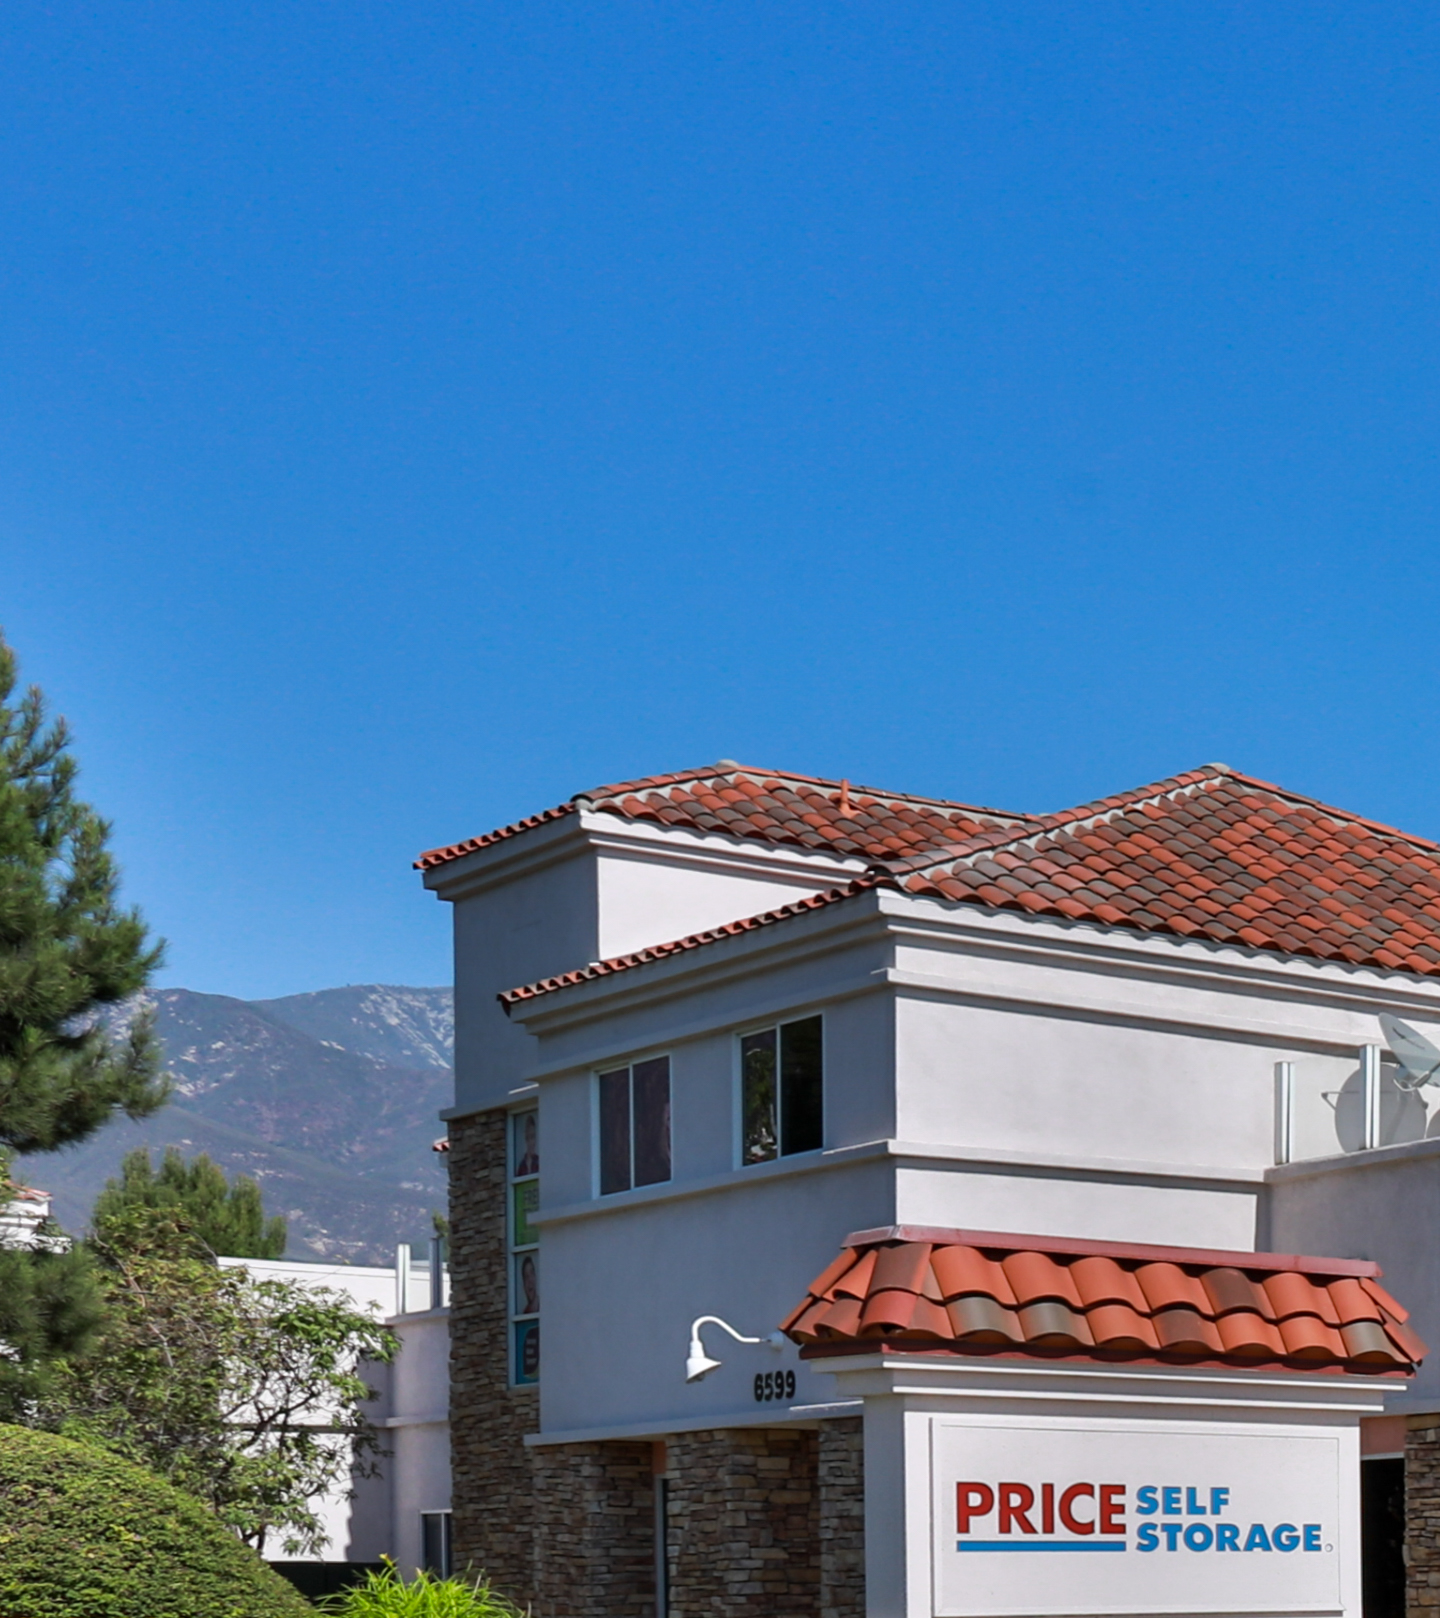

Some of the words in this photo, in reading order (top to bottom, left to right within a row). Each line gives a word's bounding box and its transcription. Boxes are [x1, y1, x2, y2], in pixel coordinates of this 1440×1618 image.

[754, 1369, 796, 1402] 6599
[956, 1482, 1127, 1535] PRICE
[1136, 1486, 1230, 1515] SELF
[1136, 1523, 1323, 1552] STORAGE
